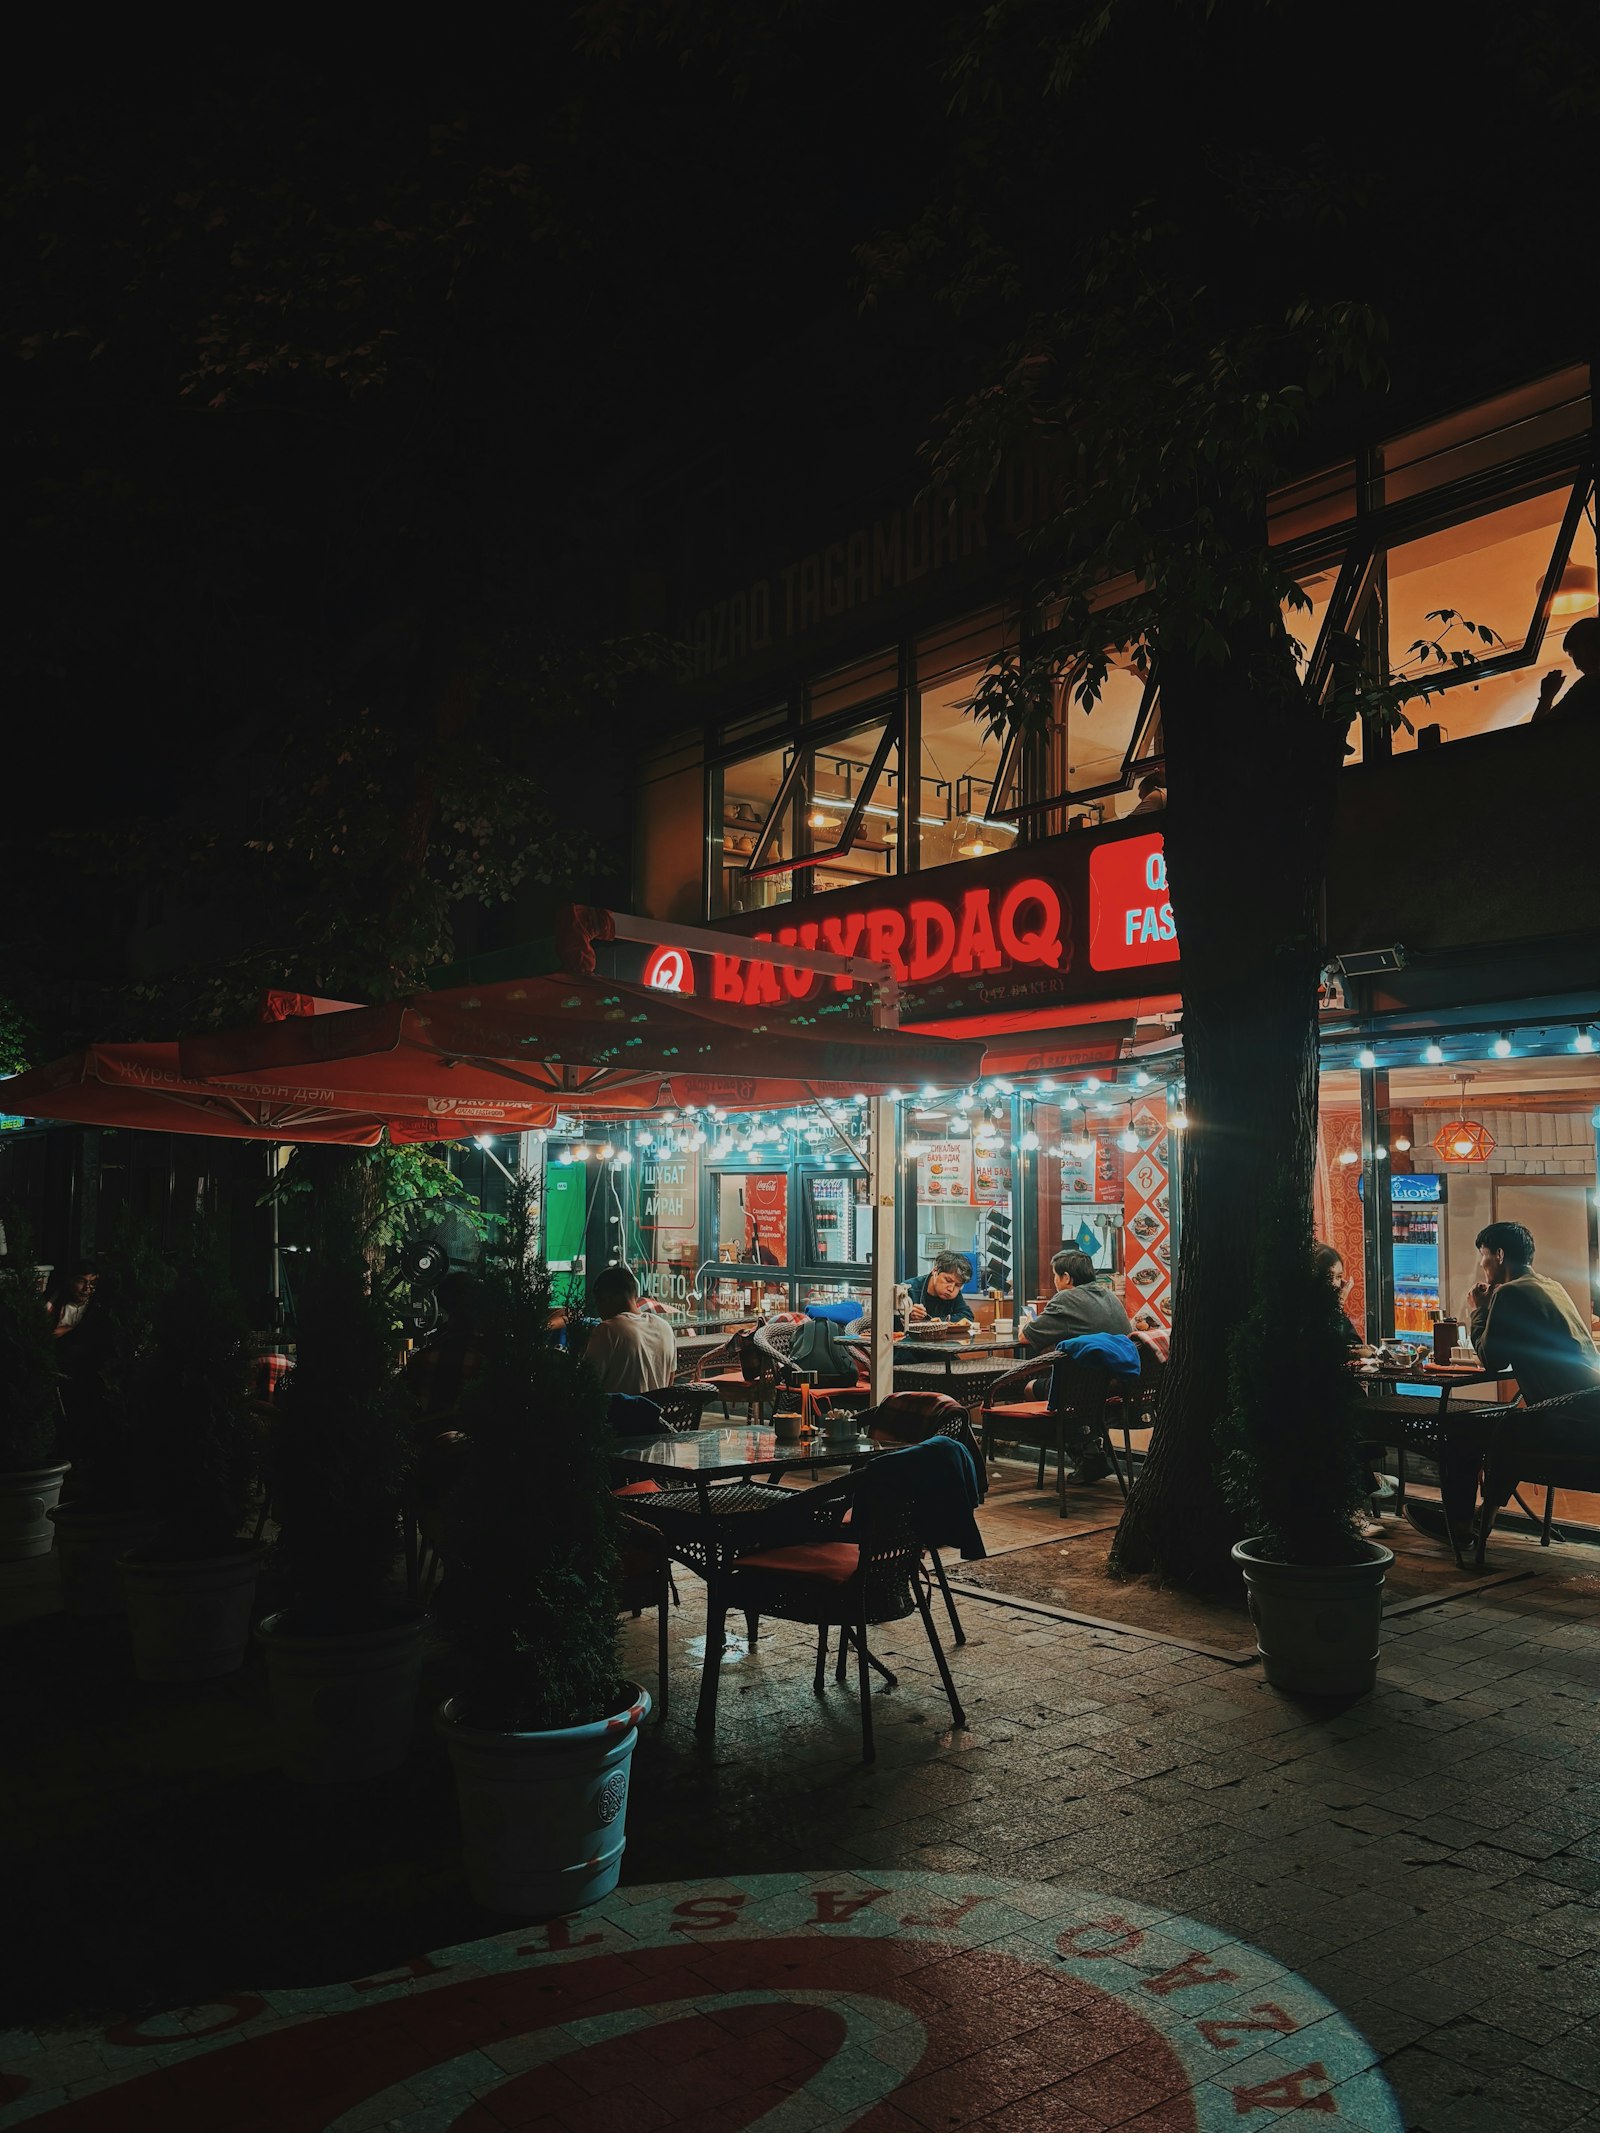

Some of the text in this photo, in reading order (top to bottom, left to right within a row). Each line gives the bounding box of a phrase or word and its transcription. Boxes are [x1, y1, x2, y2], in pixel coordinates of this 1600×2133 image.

[713, 877, 1063, 1006] BAUYRDAQ
[645, 1193, 683, 1216] АЙРАН
[640, 1272, 686, 1300] МЕСТО
